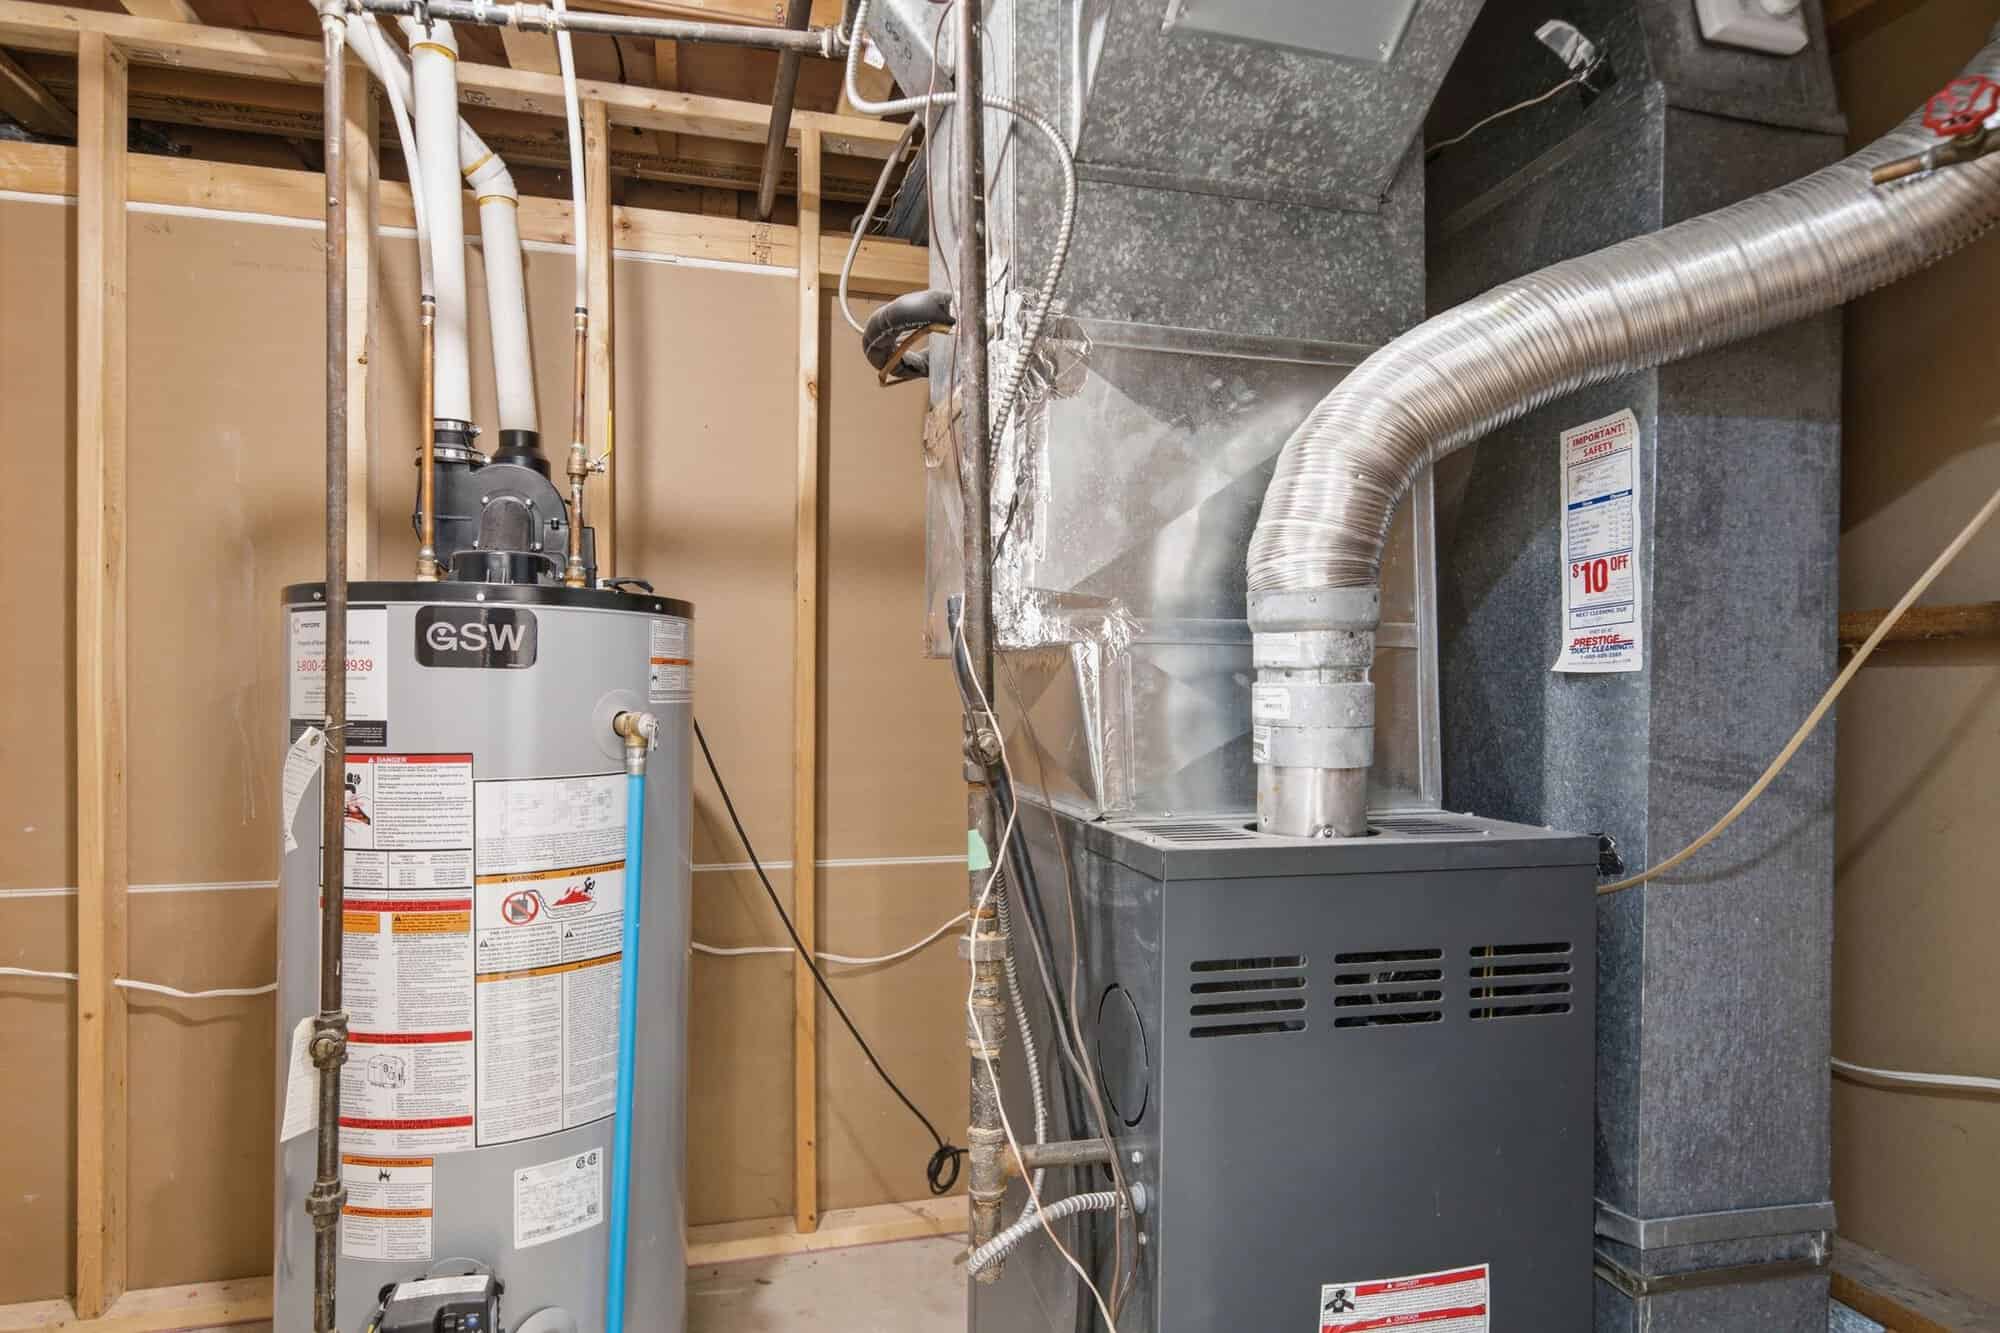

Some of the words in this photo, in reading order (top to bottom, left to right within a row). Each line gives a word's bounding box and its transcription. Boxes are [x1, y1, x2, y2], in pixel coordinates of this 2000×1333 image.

[1573, 422, 1625, 447] IMPORTANT!
[1583, 440, 1613, 457] SAFETY
[1611, 554, 1628, 571] OFF
[426, 621, 526, 652] GSW
[1574, 634, 1620, 647] PRESTIGE
